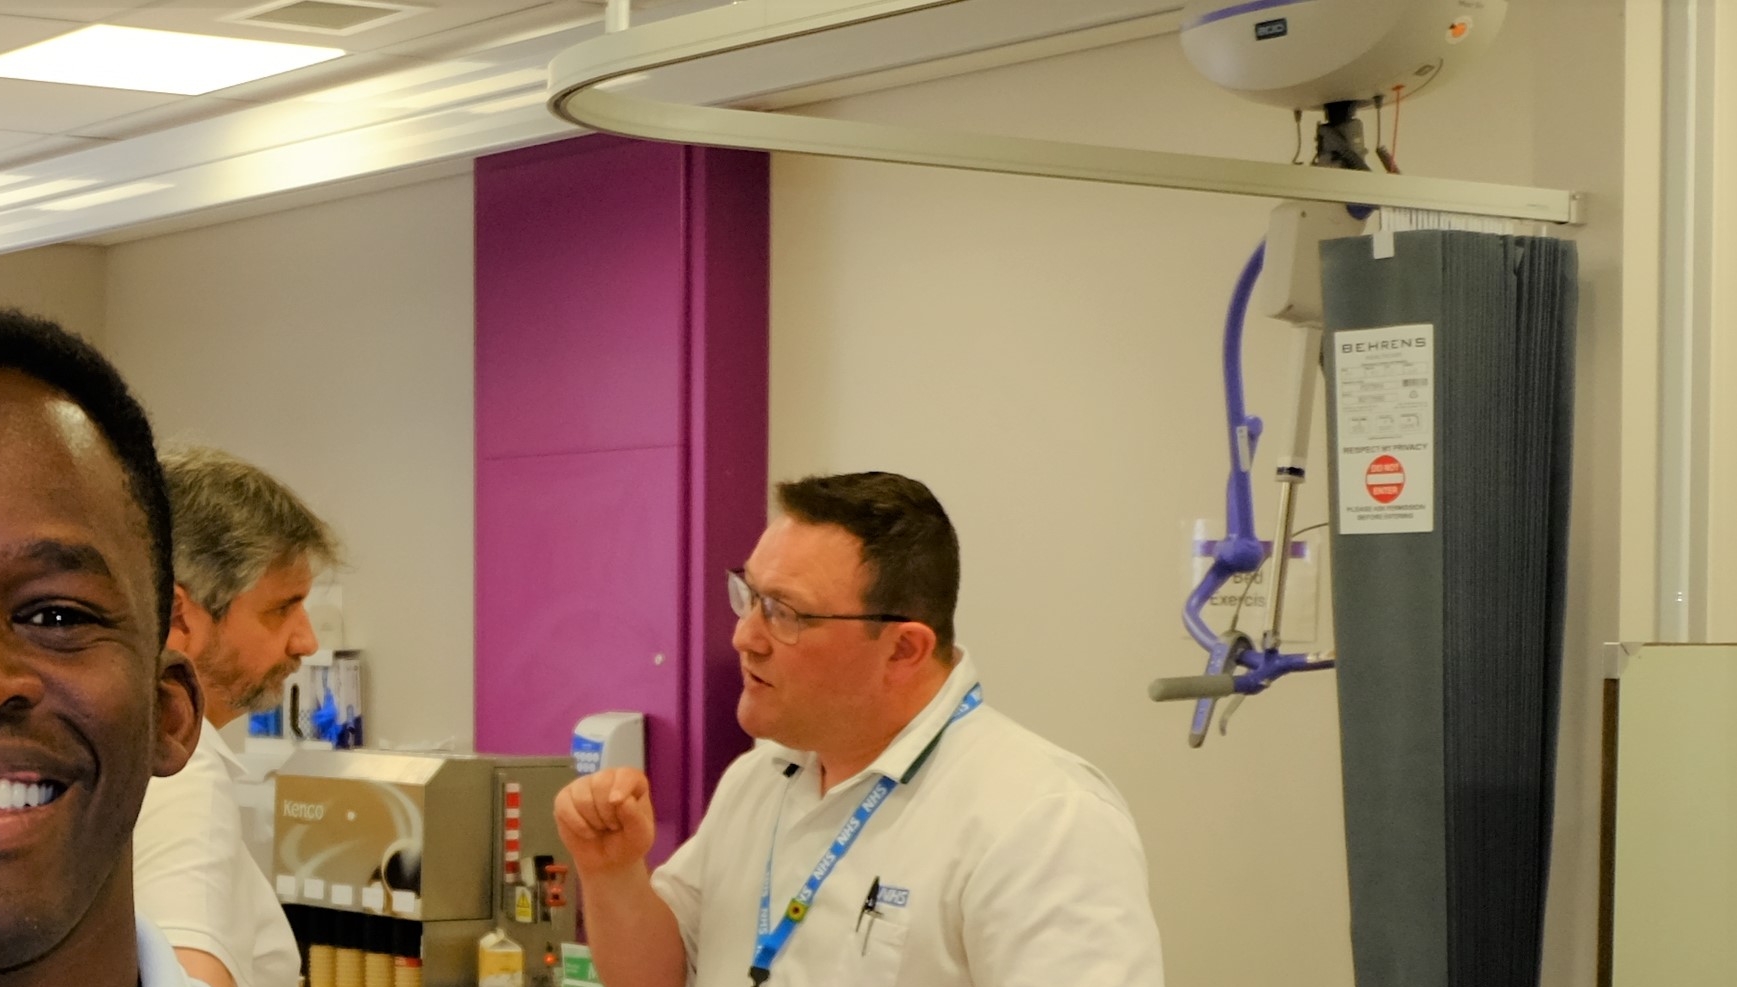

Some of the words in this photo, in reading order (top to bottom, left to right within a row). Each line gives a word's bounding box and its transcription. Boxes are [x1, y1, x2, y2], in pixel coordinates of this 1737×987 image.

[1341, 337, 1426, 353] BEHRENS
[1393, 443, 1428, 451] PRIVACY
[1209, 594, 1266, 607] Exercis
[862, 784, 887, 813] NHS
[282, 799, 325, 821] Kenco
[837, 817, 861, 846] NHS
[813, 852, 836, 880] NHS
[877, 886, 908, 905] NHS
